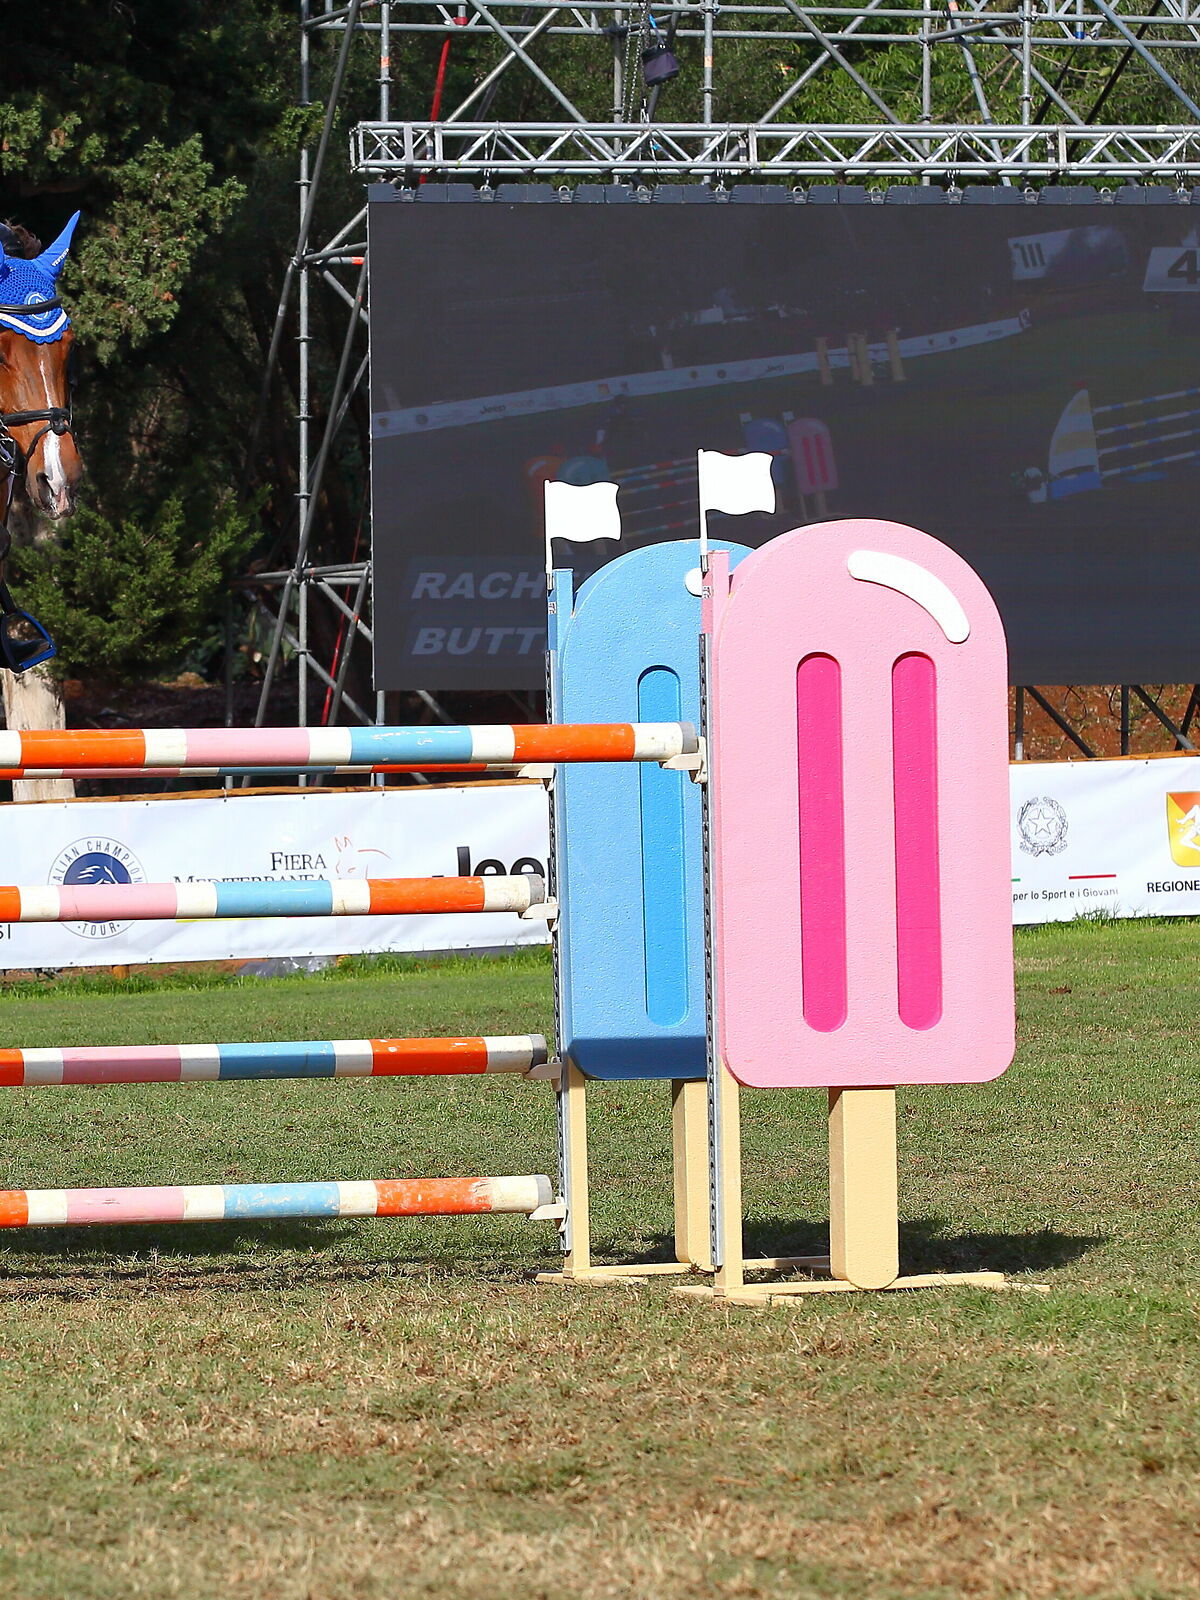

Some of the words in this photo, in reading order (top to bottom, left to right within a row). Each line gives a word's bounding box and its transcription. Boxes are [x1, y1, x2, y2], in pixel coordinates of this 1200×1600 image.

[411, 572, 546, 599] RACH
[411, 627, 547, 655] BUTT
[53, 847, 80, 882] ALIAN
[86, 840, 143, 883] CHAMPION
[270, 851, 327, 871] FIERA
[1012, 892, 1028, 903] per
[1031, 890, 1039, 900] lo
[1042, 890, 1067, 901] Sport
[1070, 890, 1075, 898] e
[1083, 888, 1119, 898] Giovani
[1147, 880, 1200, 893] REGIONE
[82, 922, 117, 936] TOUR
